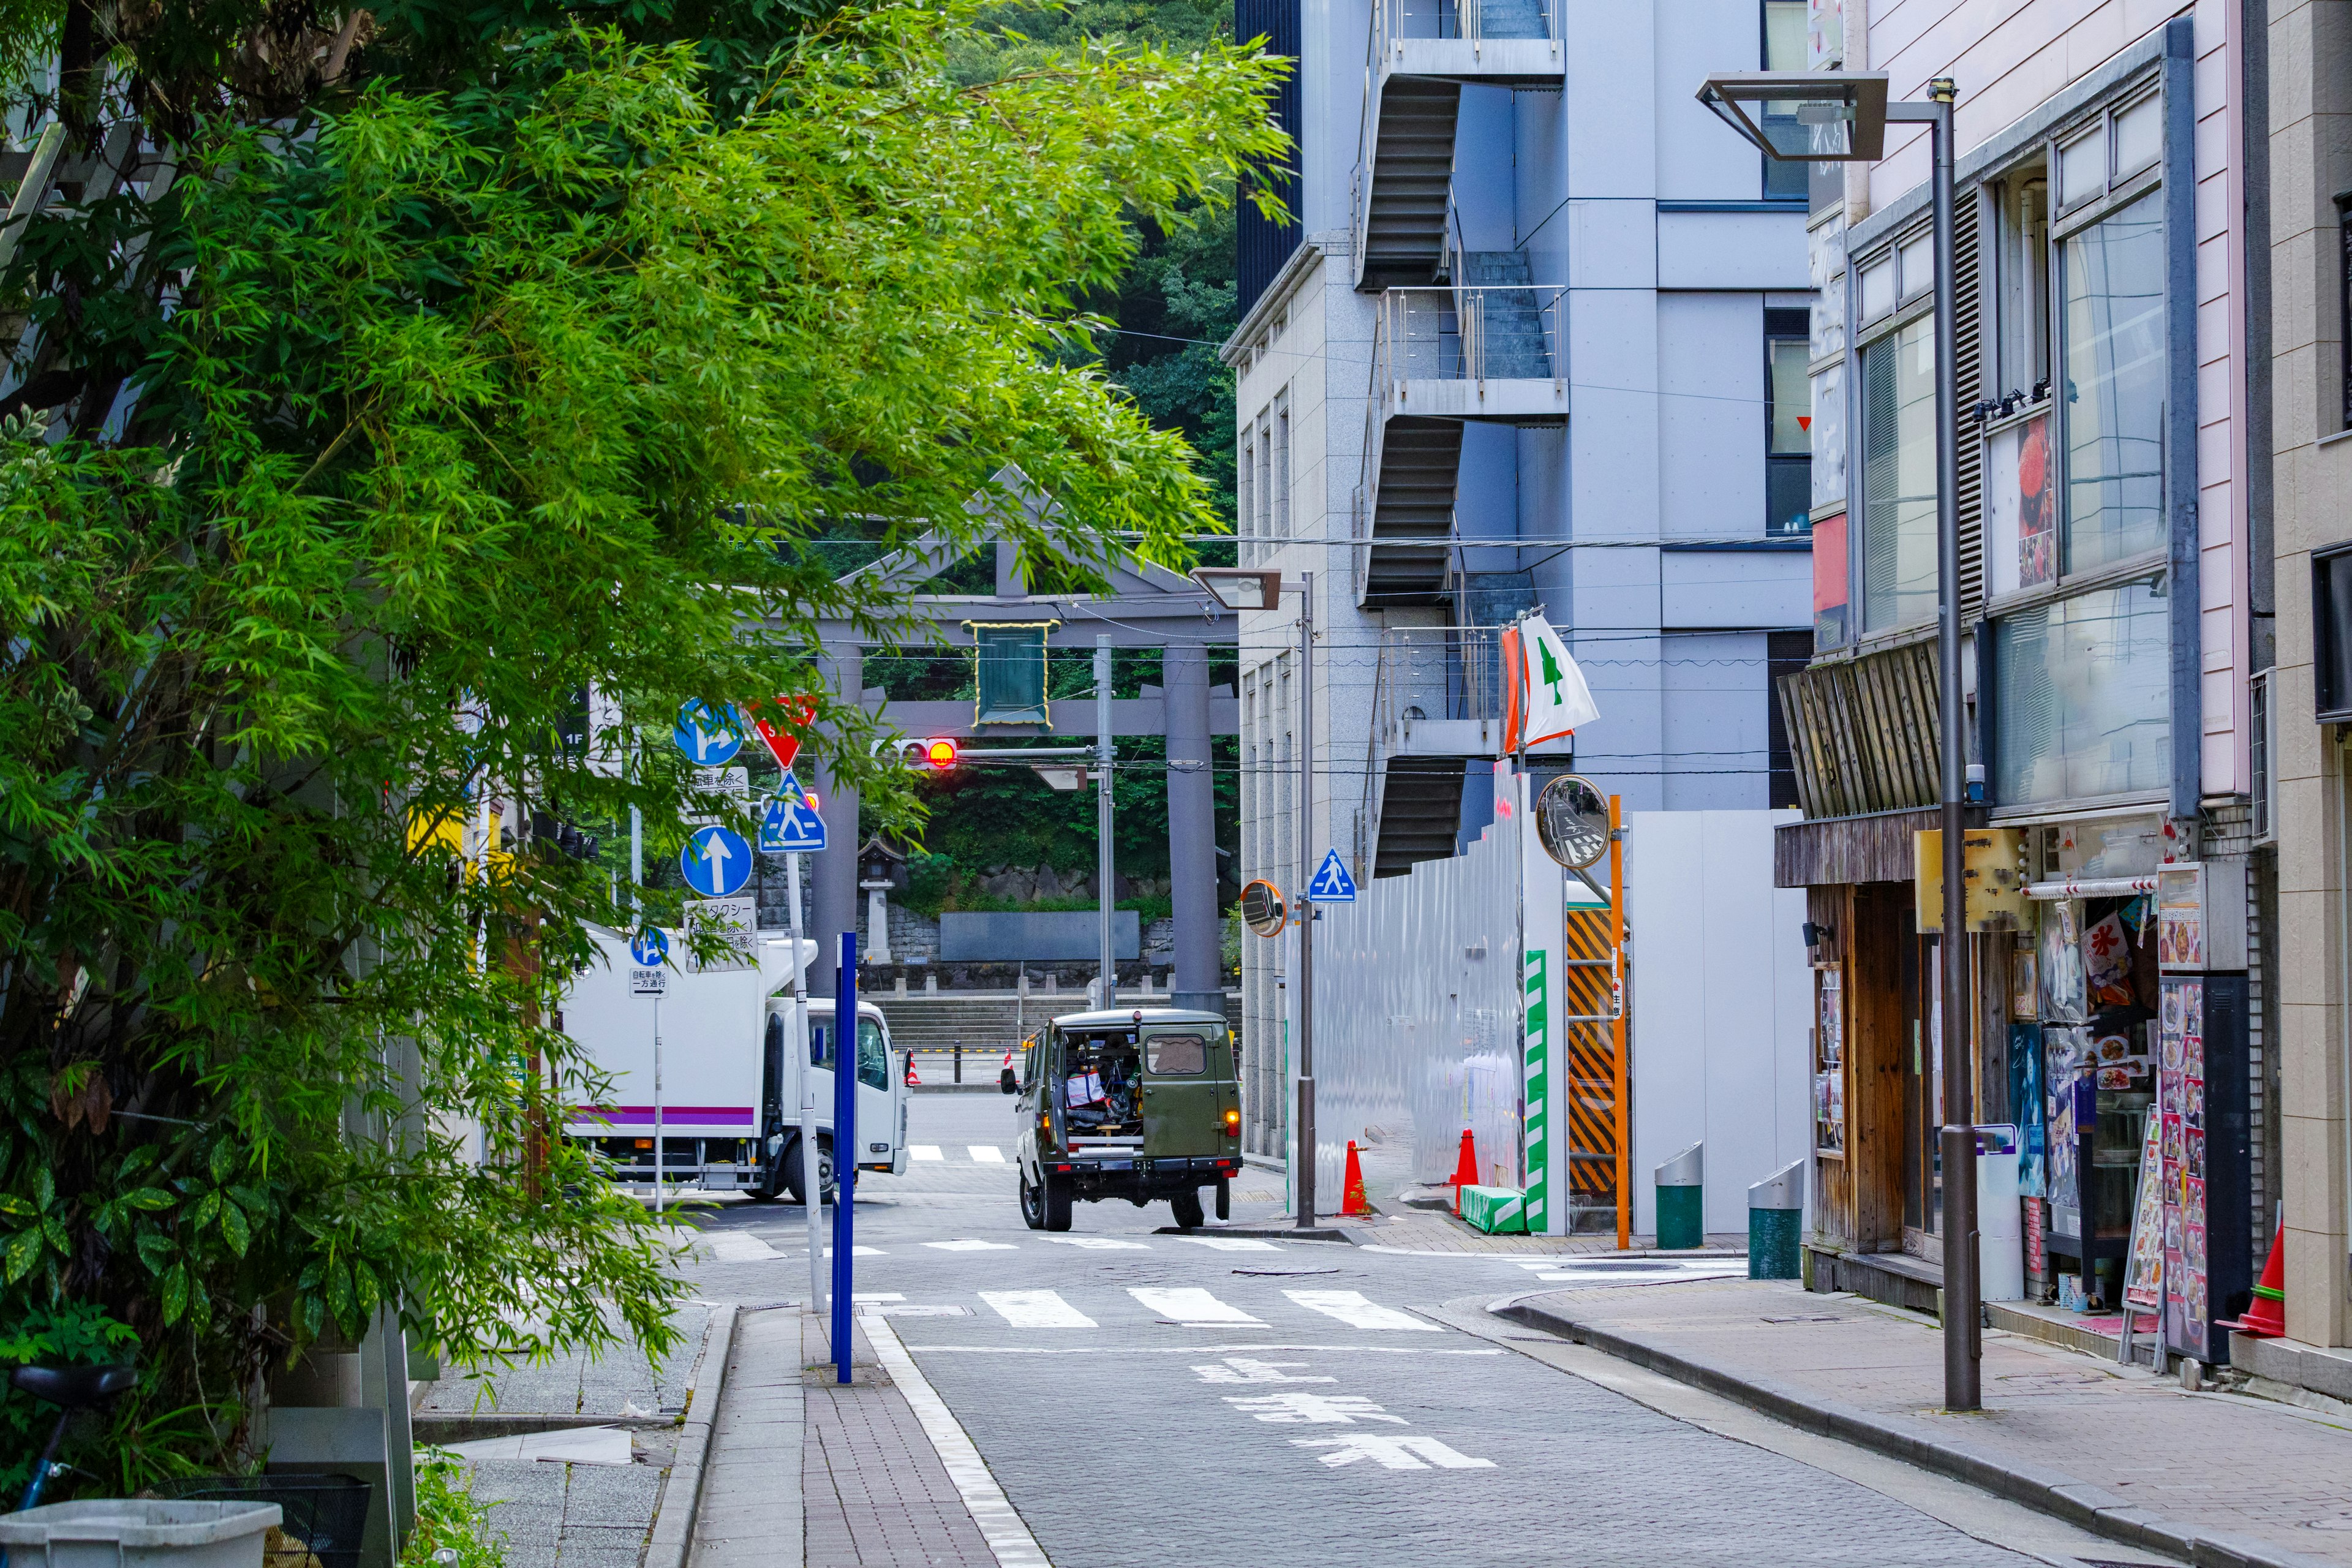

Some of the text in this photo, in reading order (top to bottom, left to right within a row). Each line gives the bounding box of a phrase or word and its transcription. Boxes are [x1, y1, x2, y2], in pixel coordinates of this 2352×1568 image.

[567, 734, 582, 744] 1F
[2092, 924, 2119, 956] 氷
[1189, 1358, 1499, 1469] 止まれ
